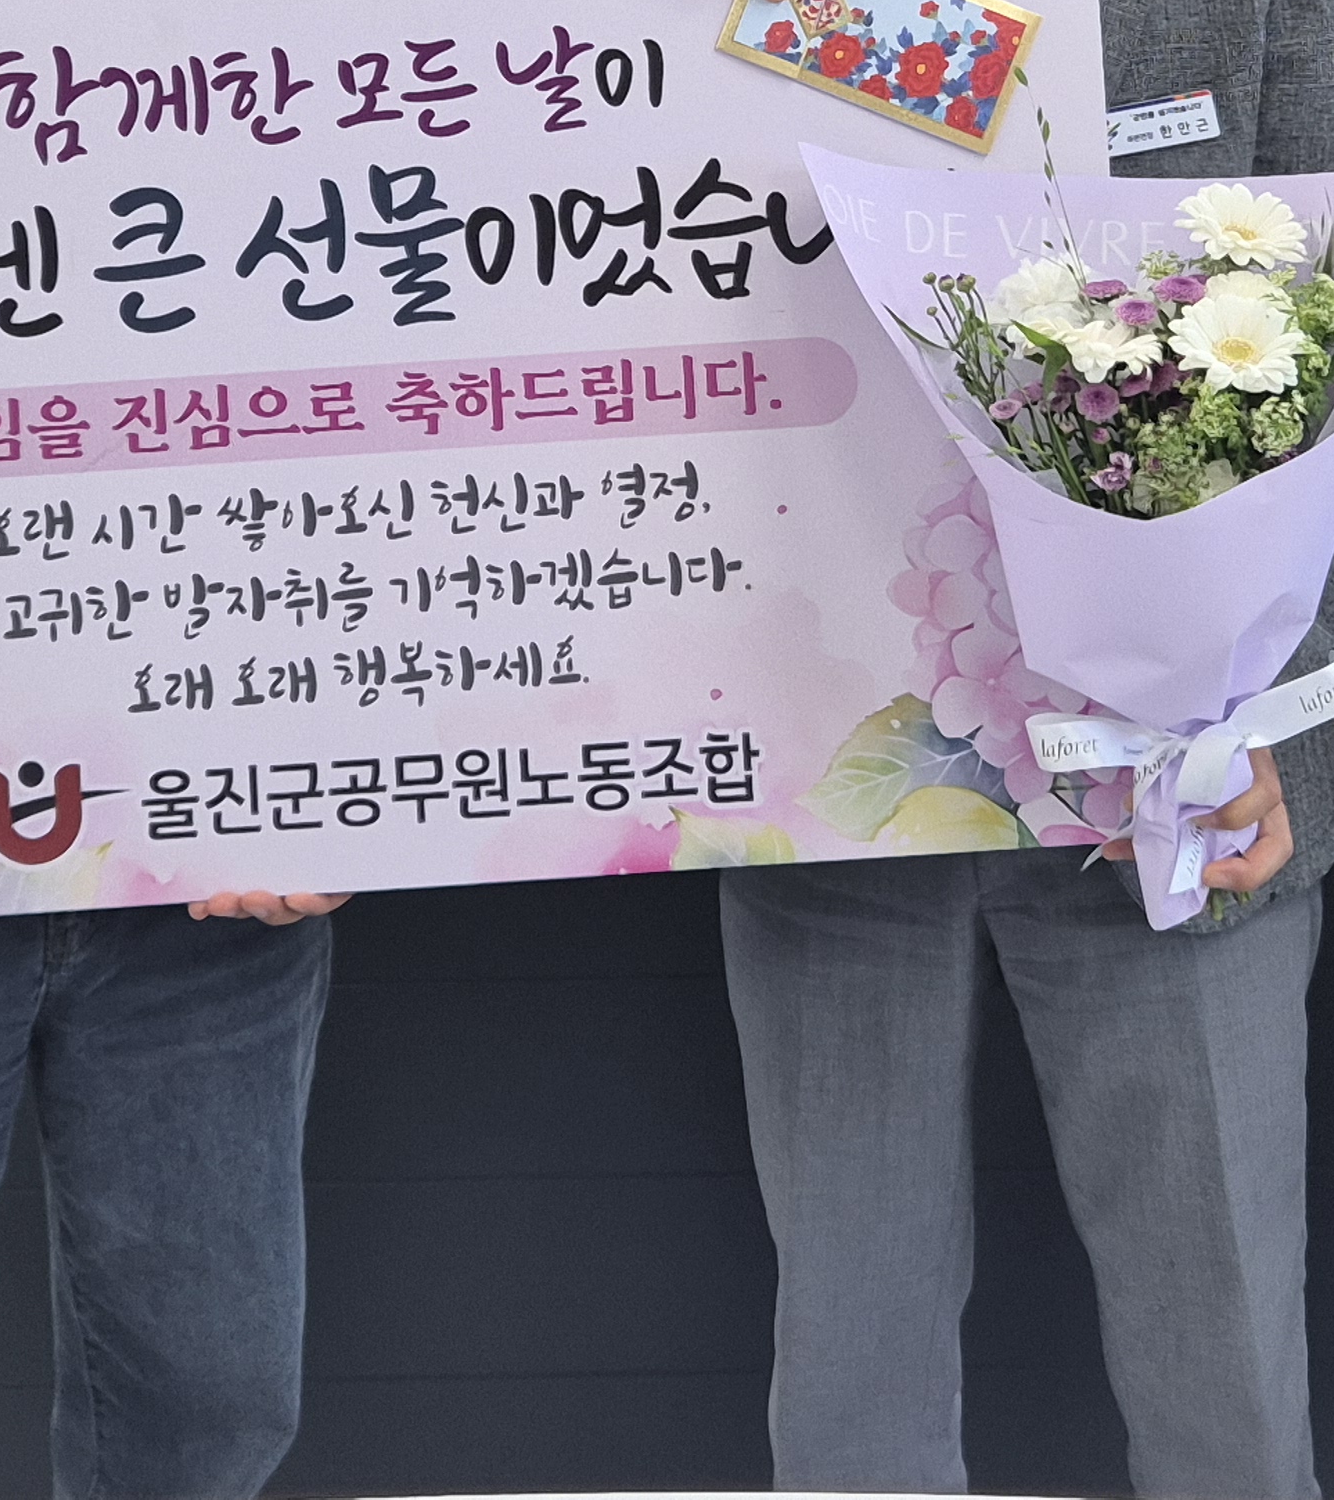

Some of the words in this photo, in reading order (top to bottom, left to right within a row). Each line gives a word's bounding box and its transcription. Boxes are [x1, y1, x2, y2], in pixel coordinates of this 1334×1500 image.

[335, 36, 478, 138] 모든
[495, 24, 666, 133] 날이
[92, 185, 207, 335] 큰
[233, 157, 835, 327] 선물이었습
[822, 183, 883, 244] OIE
[903, 210, 968, 258] DE
[111, 379, 368, 455] 진심으로
[383, 350, 785, 437] 축하드립니다.
[90, 492, 203, 555] 시간
[215, 479, 417, 552] 쌓아오신
[429, 471, 586, 535] 헌신과
[2, 584, 150, 644] 고귀한
[162, 561, 374, 640] 발자취를
[389, 546, 754, 621] 기억하겠습니다.
[127, 661, 215, 714] 오래
[230, 655, 318, 708] 오래
[332, 633, 592, 709] 행복하세요.
[139, 730, 762, 841] 울진군공무원노동조합
[1040, 734, 1100, 764] laforet
